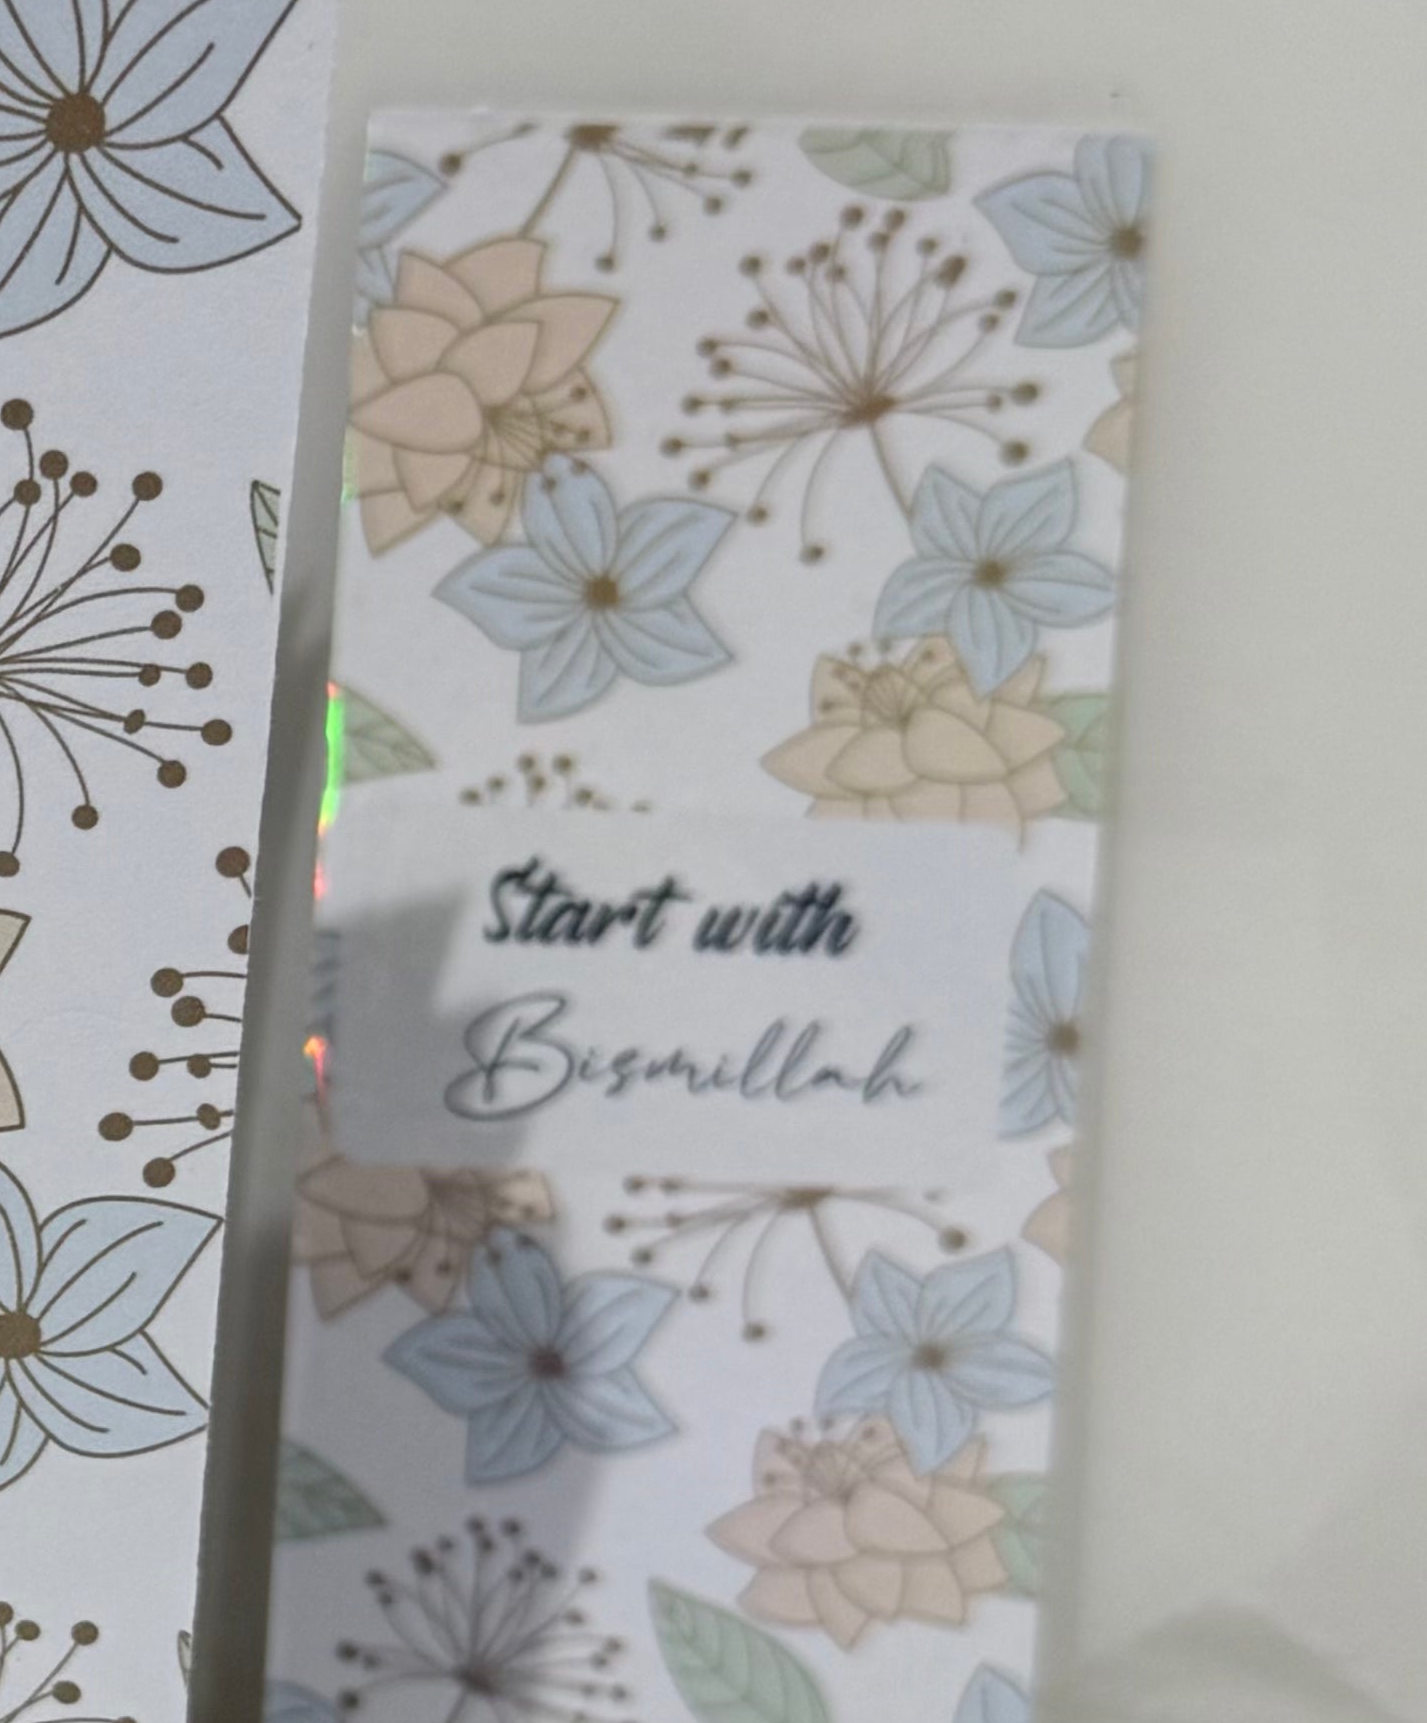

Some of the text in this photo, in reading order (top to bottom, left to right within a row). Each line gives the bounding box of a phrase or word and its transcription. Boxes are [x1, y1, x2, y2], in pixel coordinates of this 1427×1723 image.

[483, 856, 862, 958] Start with
[445, 990, 922, 1122] Bismillah
